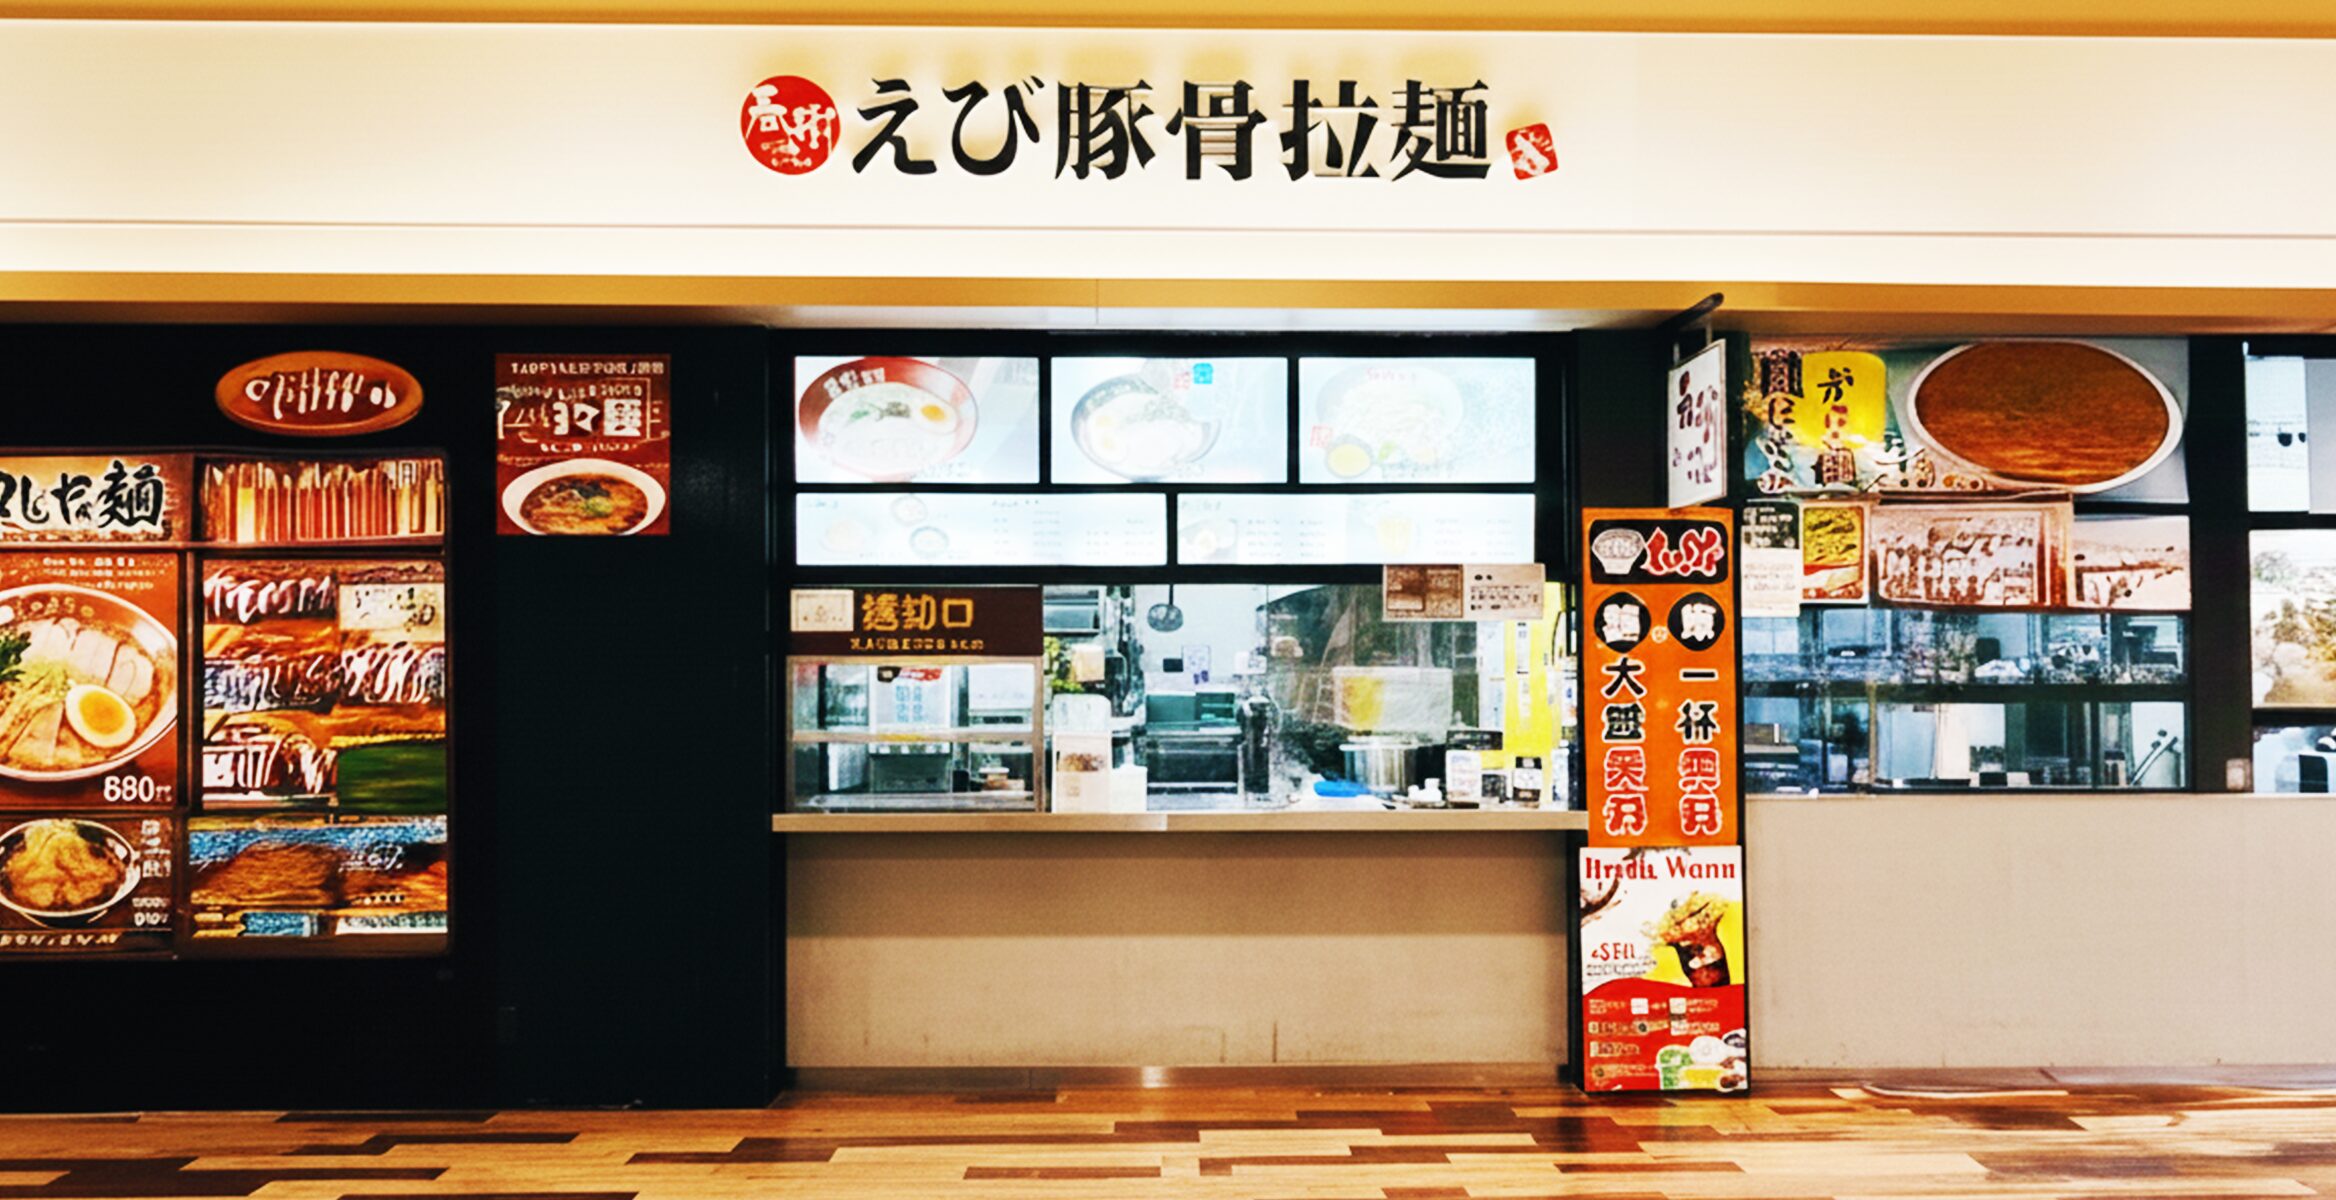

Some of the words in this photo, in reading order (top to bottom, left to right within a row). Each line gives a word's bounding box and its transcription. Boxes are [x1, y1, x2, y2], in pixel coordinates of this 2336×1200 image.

[852, 75, 1492, 182] えび豚骨拉麺
